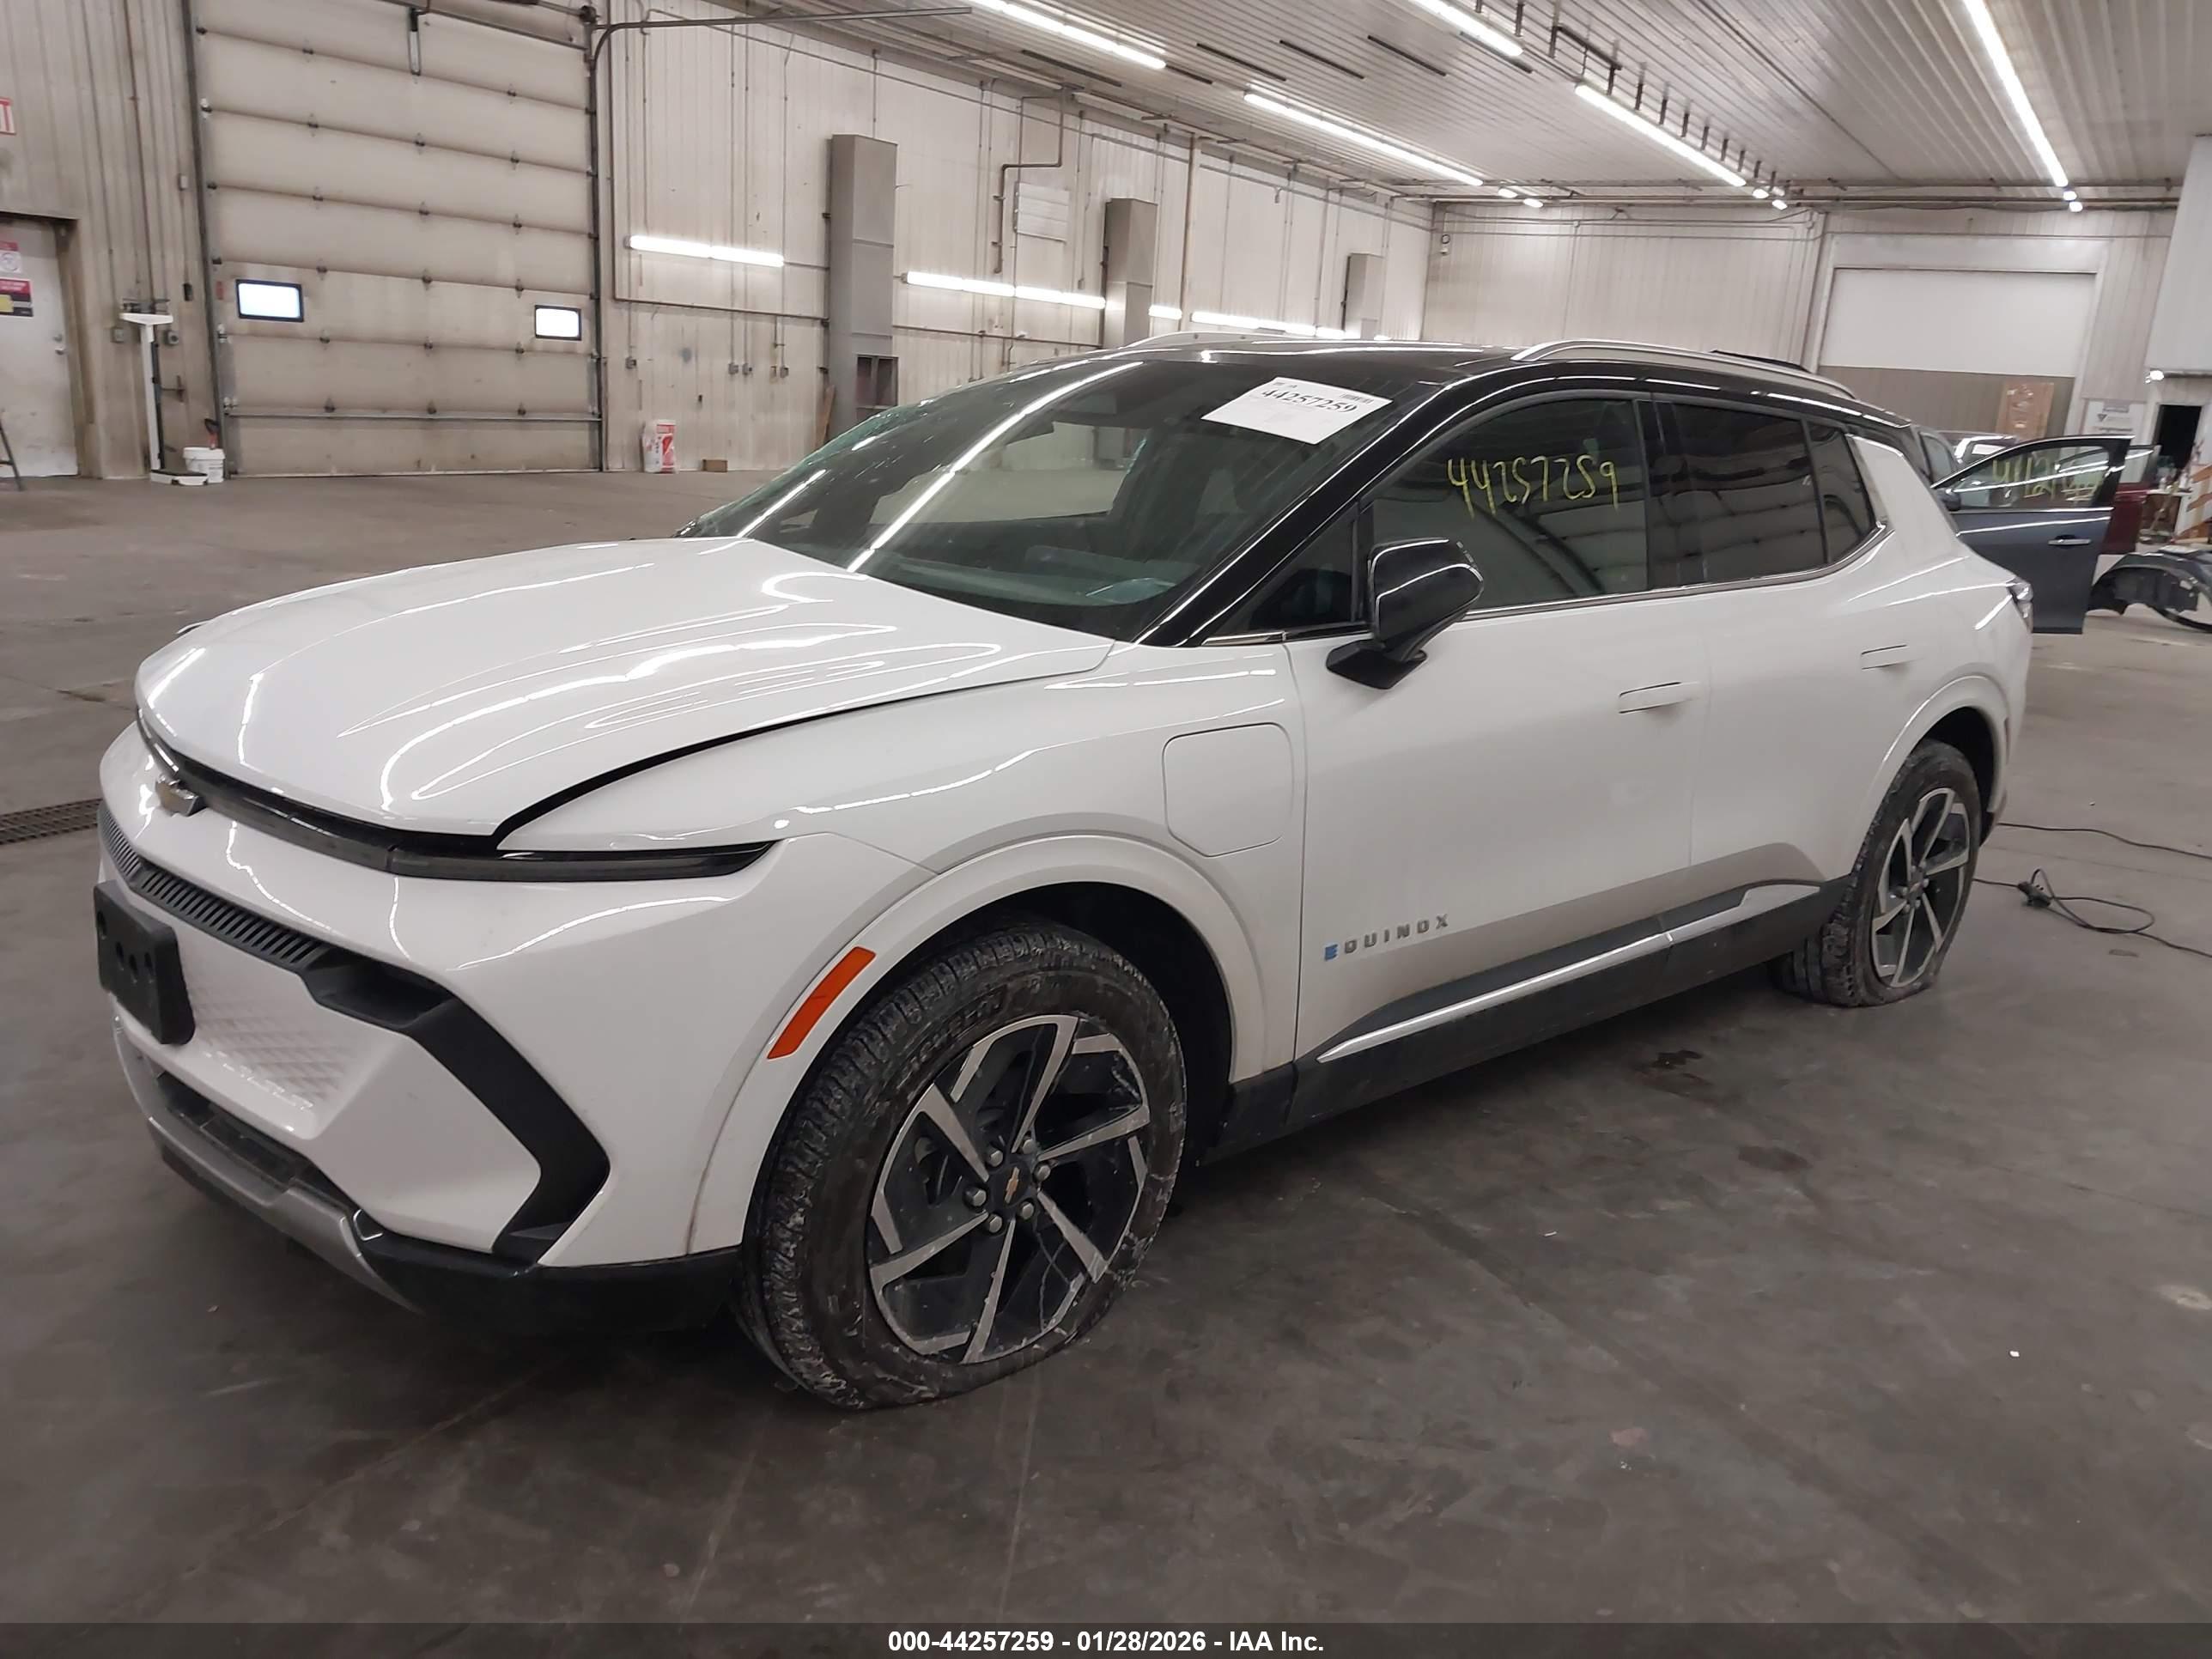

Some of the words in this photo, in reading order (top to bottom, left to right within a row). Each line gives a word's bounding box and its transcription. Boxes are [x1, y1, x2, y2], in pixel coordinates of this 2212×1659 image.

[1261, 389, 1358, 413] 44257259
[1447, 454, 1620, 518] 44257259
[1323, 913, 1449, 962] EQUINOX
